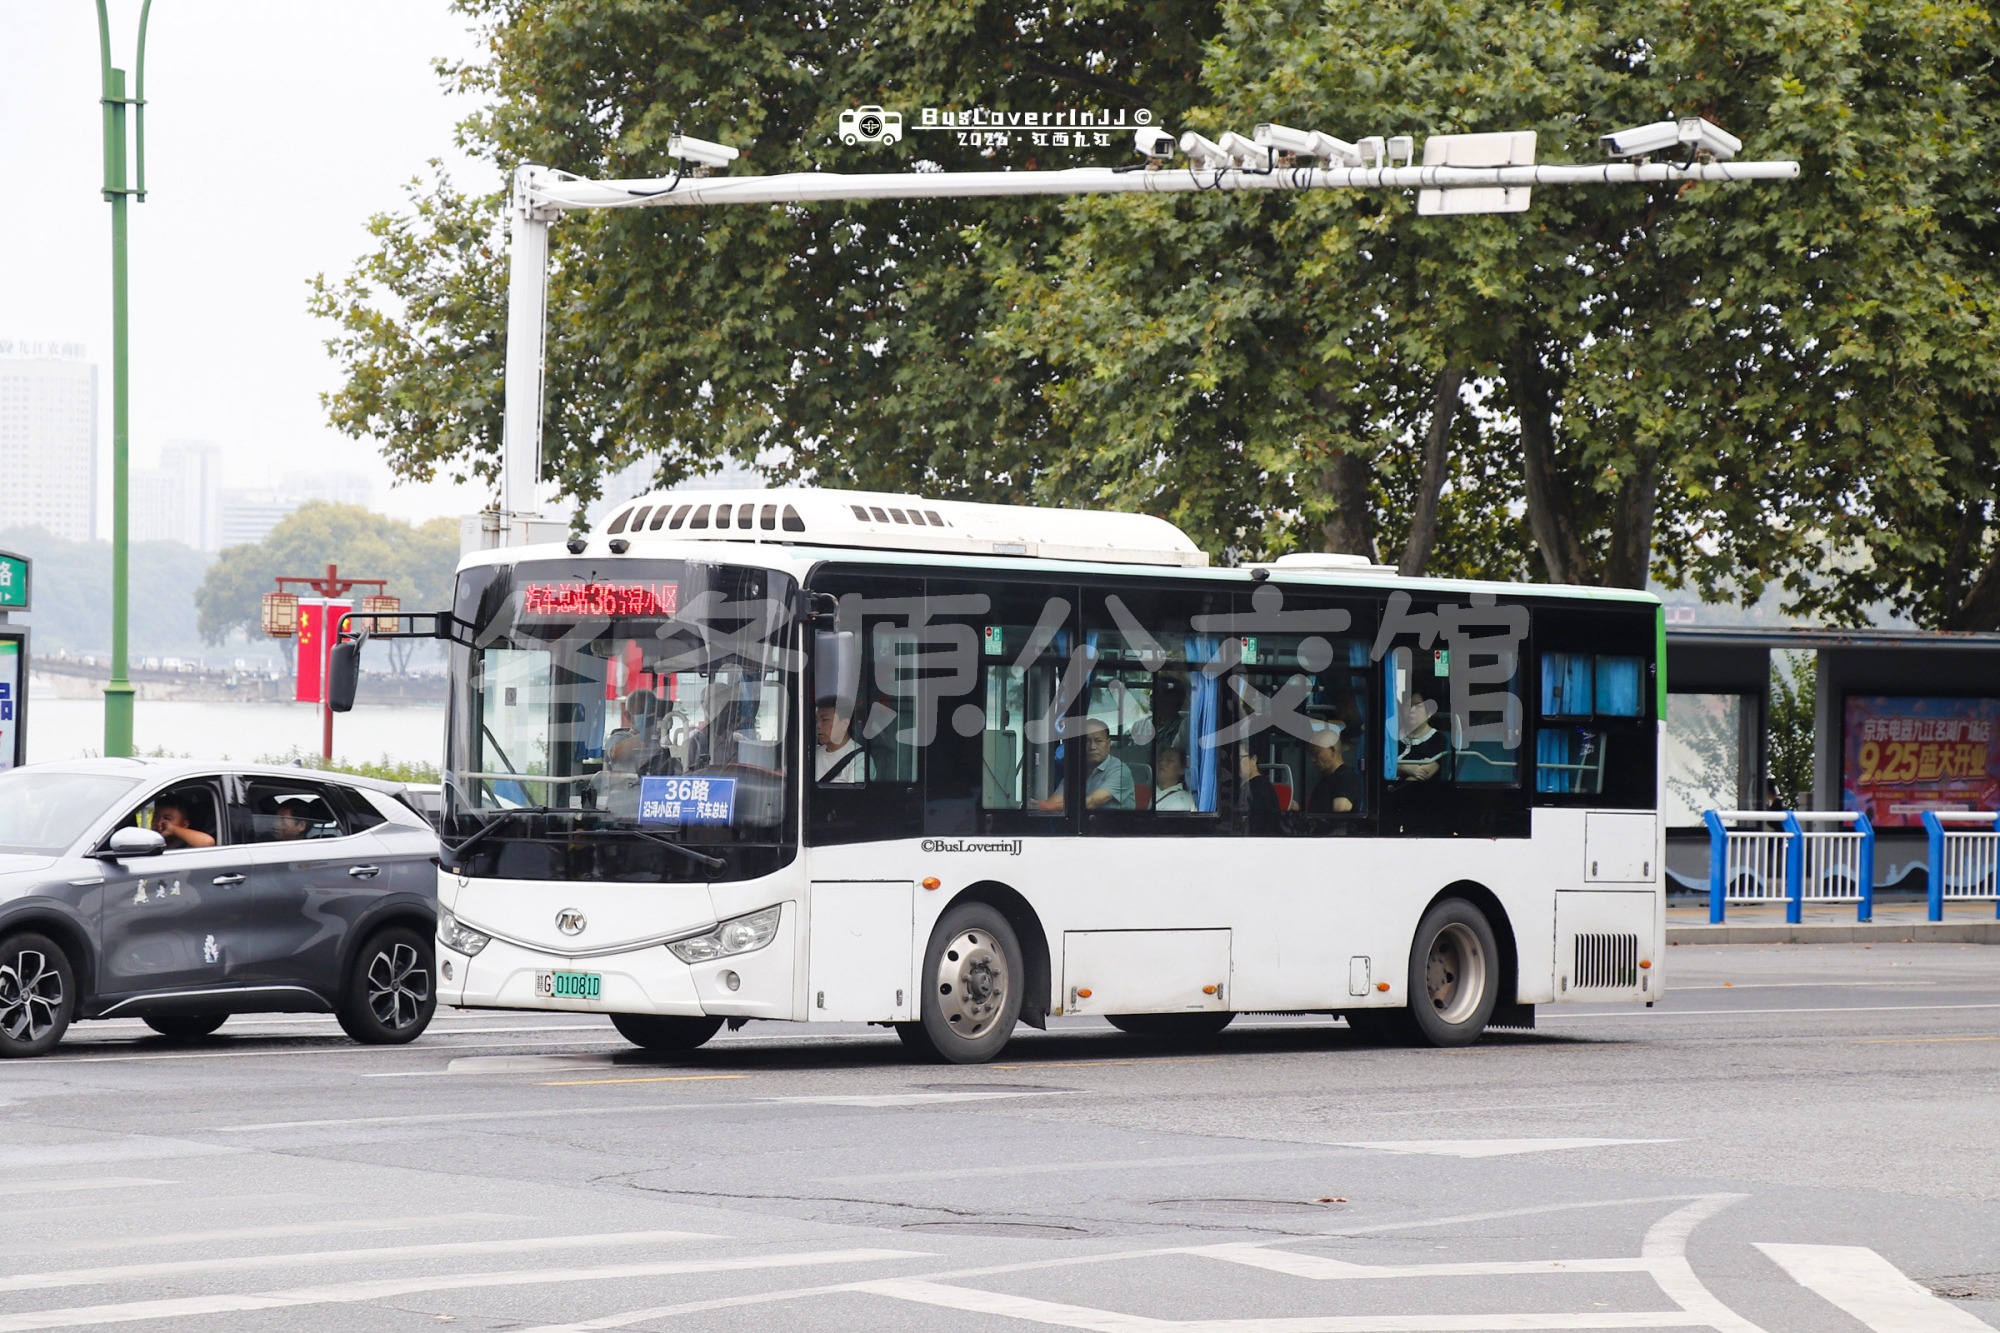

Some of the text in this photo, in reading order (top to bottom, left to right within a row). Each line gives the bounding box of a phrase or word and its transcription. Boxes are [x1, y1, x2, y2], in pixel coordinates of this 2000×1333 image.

[1858, 741, 1988, 782] 9.25盛大开业
[665, 780, 709, 802] 36路
